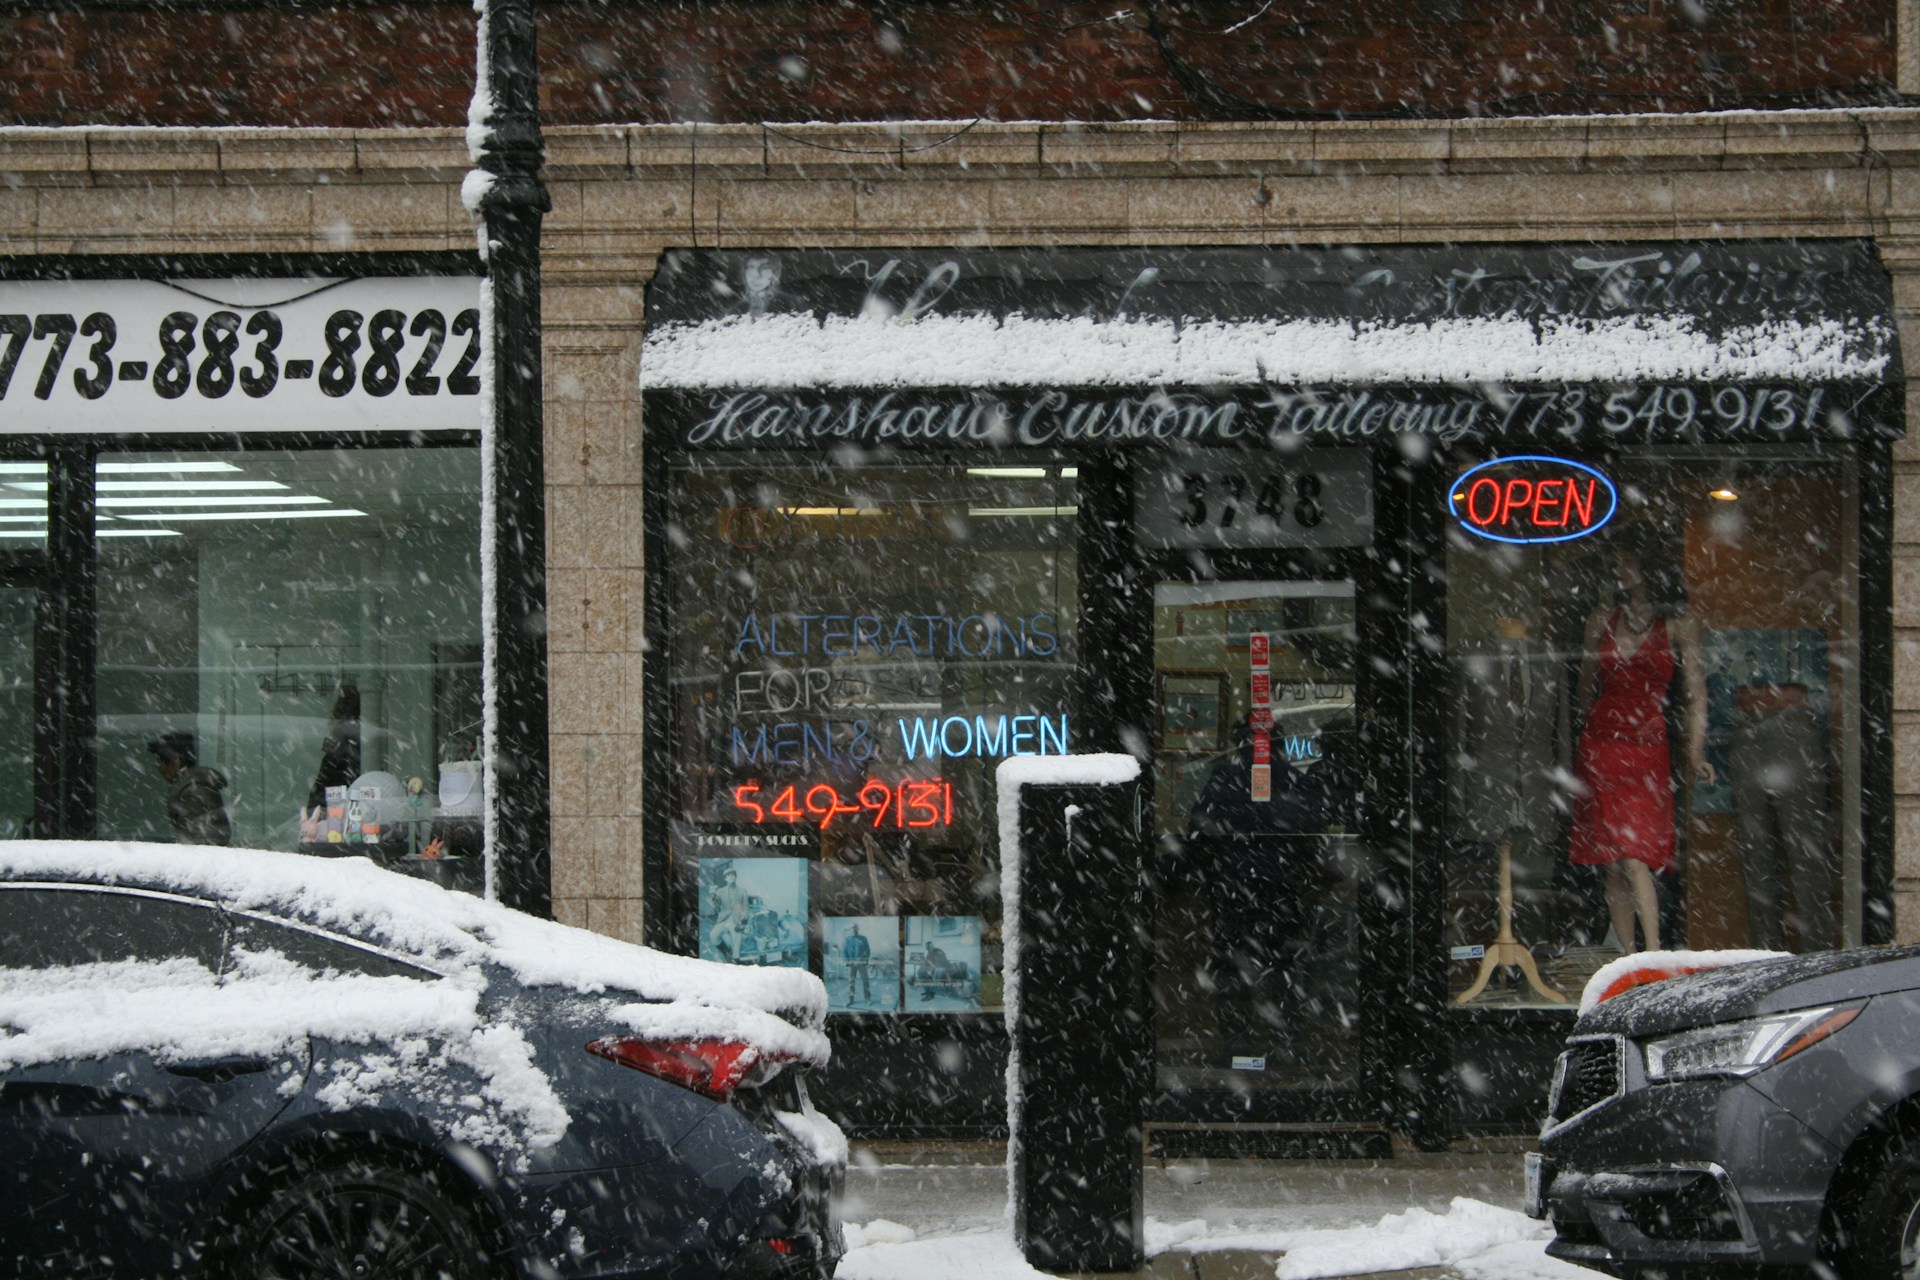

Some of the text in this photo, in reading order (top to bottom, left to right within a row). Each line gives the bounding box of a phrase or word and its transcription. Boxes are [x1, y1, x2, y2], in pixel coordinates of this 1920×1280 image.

[0, 308, 481, 400] 773-883-8822
[688, 386, 1825, 446] Hanshaw Custom Tailoring 773 549-9131
[1179, 472, 1324, 528] 3748
[1467, 478, 1596, 527] OPEN
[735, 613, 1058, 657] ALTERATIONS
[735, 667, 832, 714] FOR
[731, 713, 1069, 767] MEN & WOMEN
[734, 781, 953, 829] 549-9131
[698, 834, 808, 846] POVERTY SUCKS
